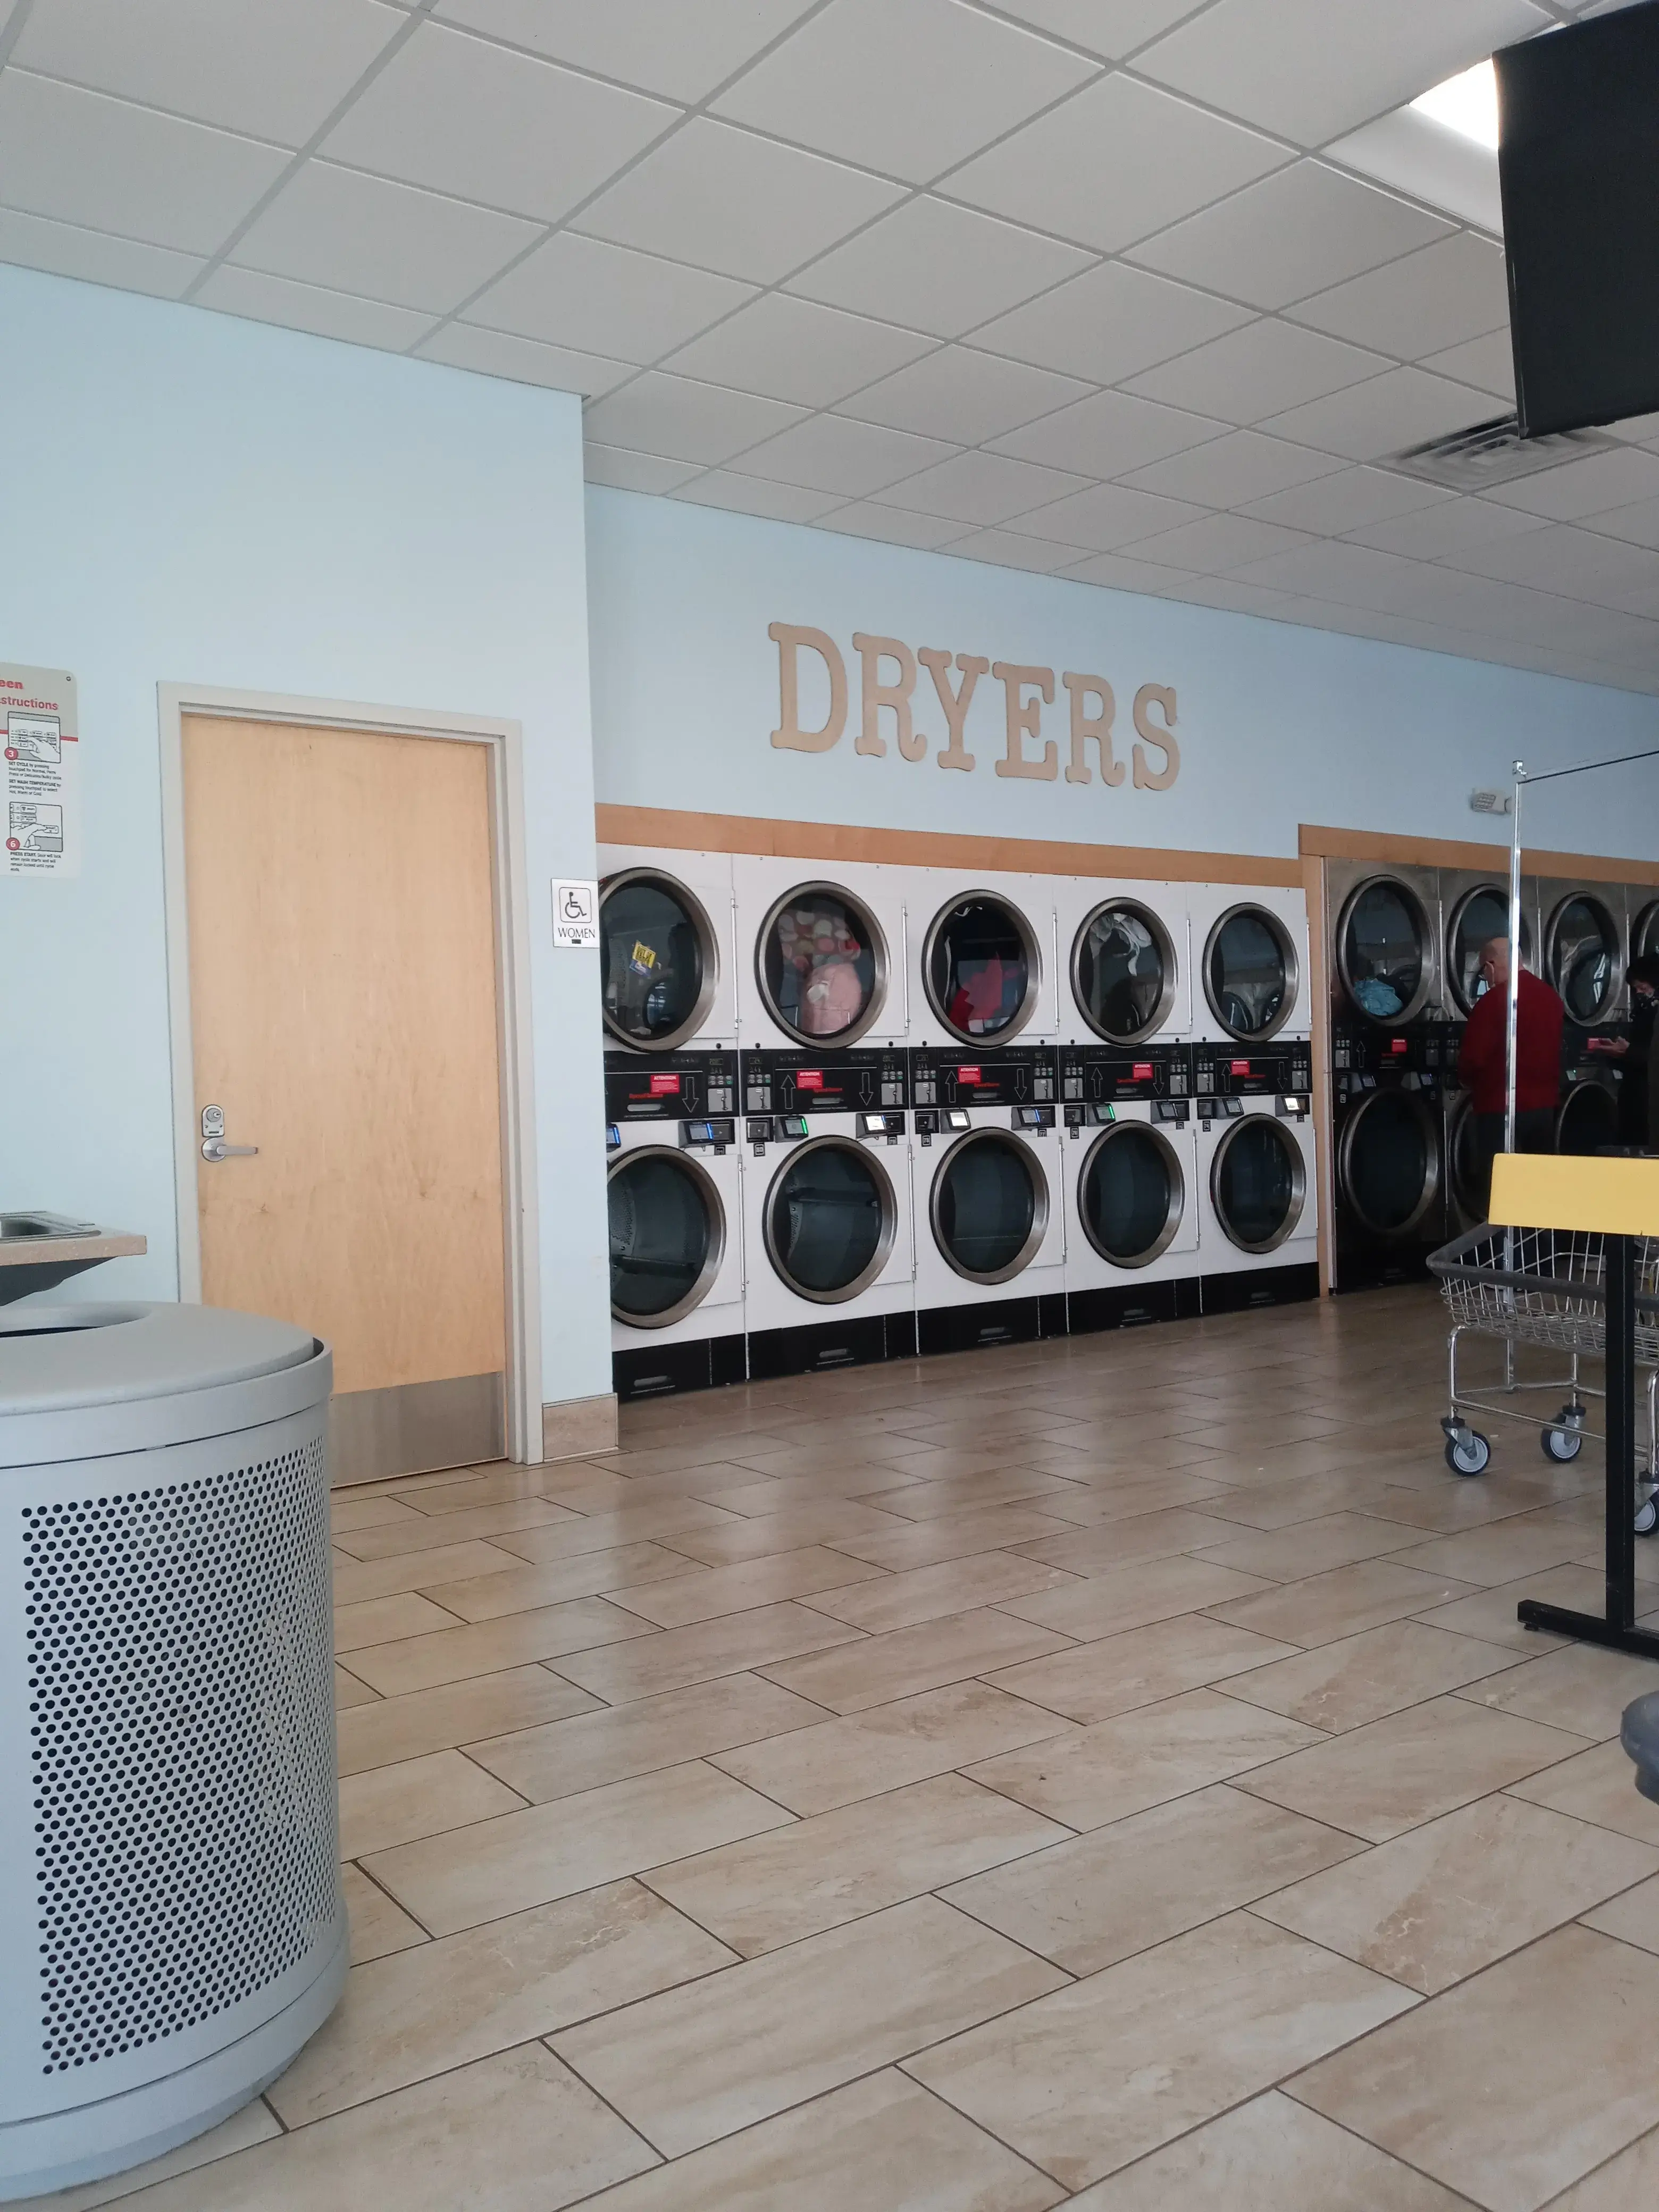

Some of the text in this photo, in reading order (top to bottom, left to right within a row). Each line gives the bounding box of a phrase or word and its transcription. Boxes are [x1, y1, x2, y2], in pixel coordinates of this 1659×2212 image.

[0, 696, 59, 710] structions
[768, 622, 1180, 791] DRYERS
[557, 927, 596, 939] WOMEN
